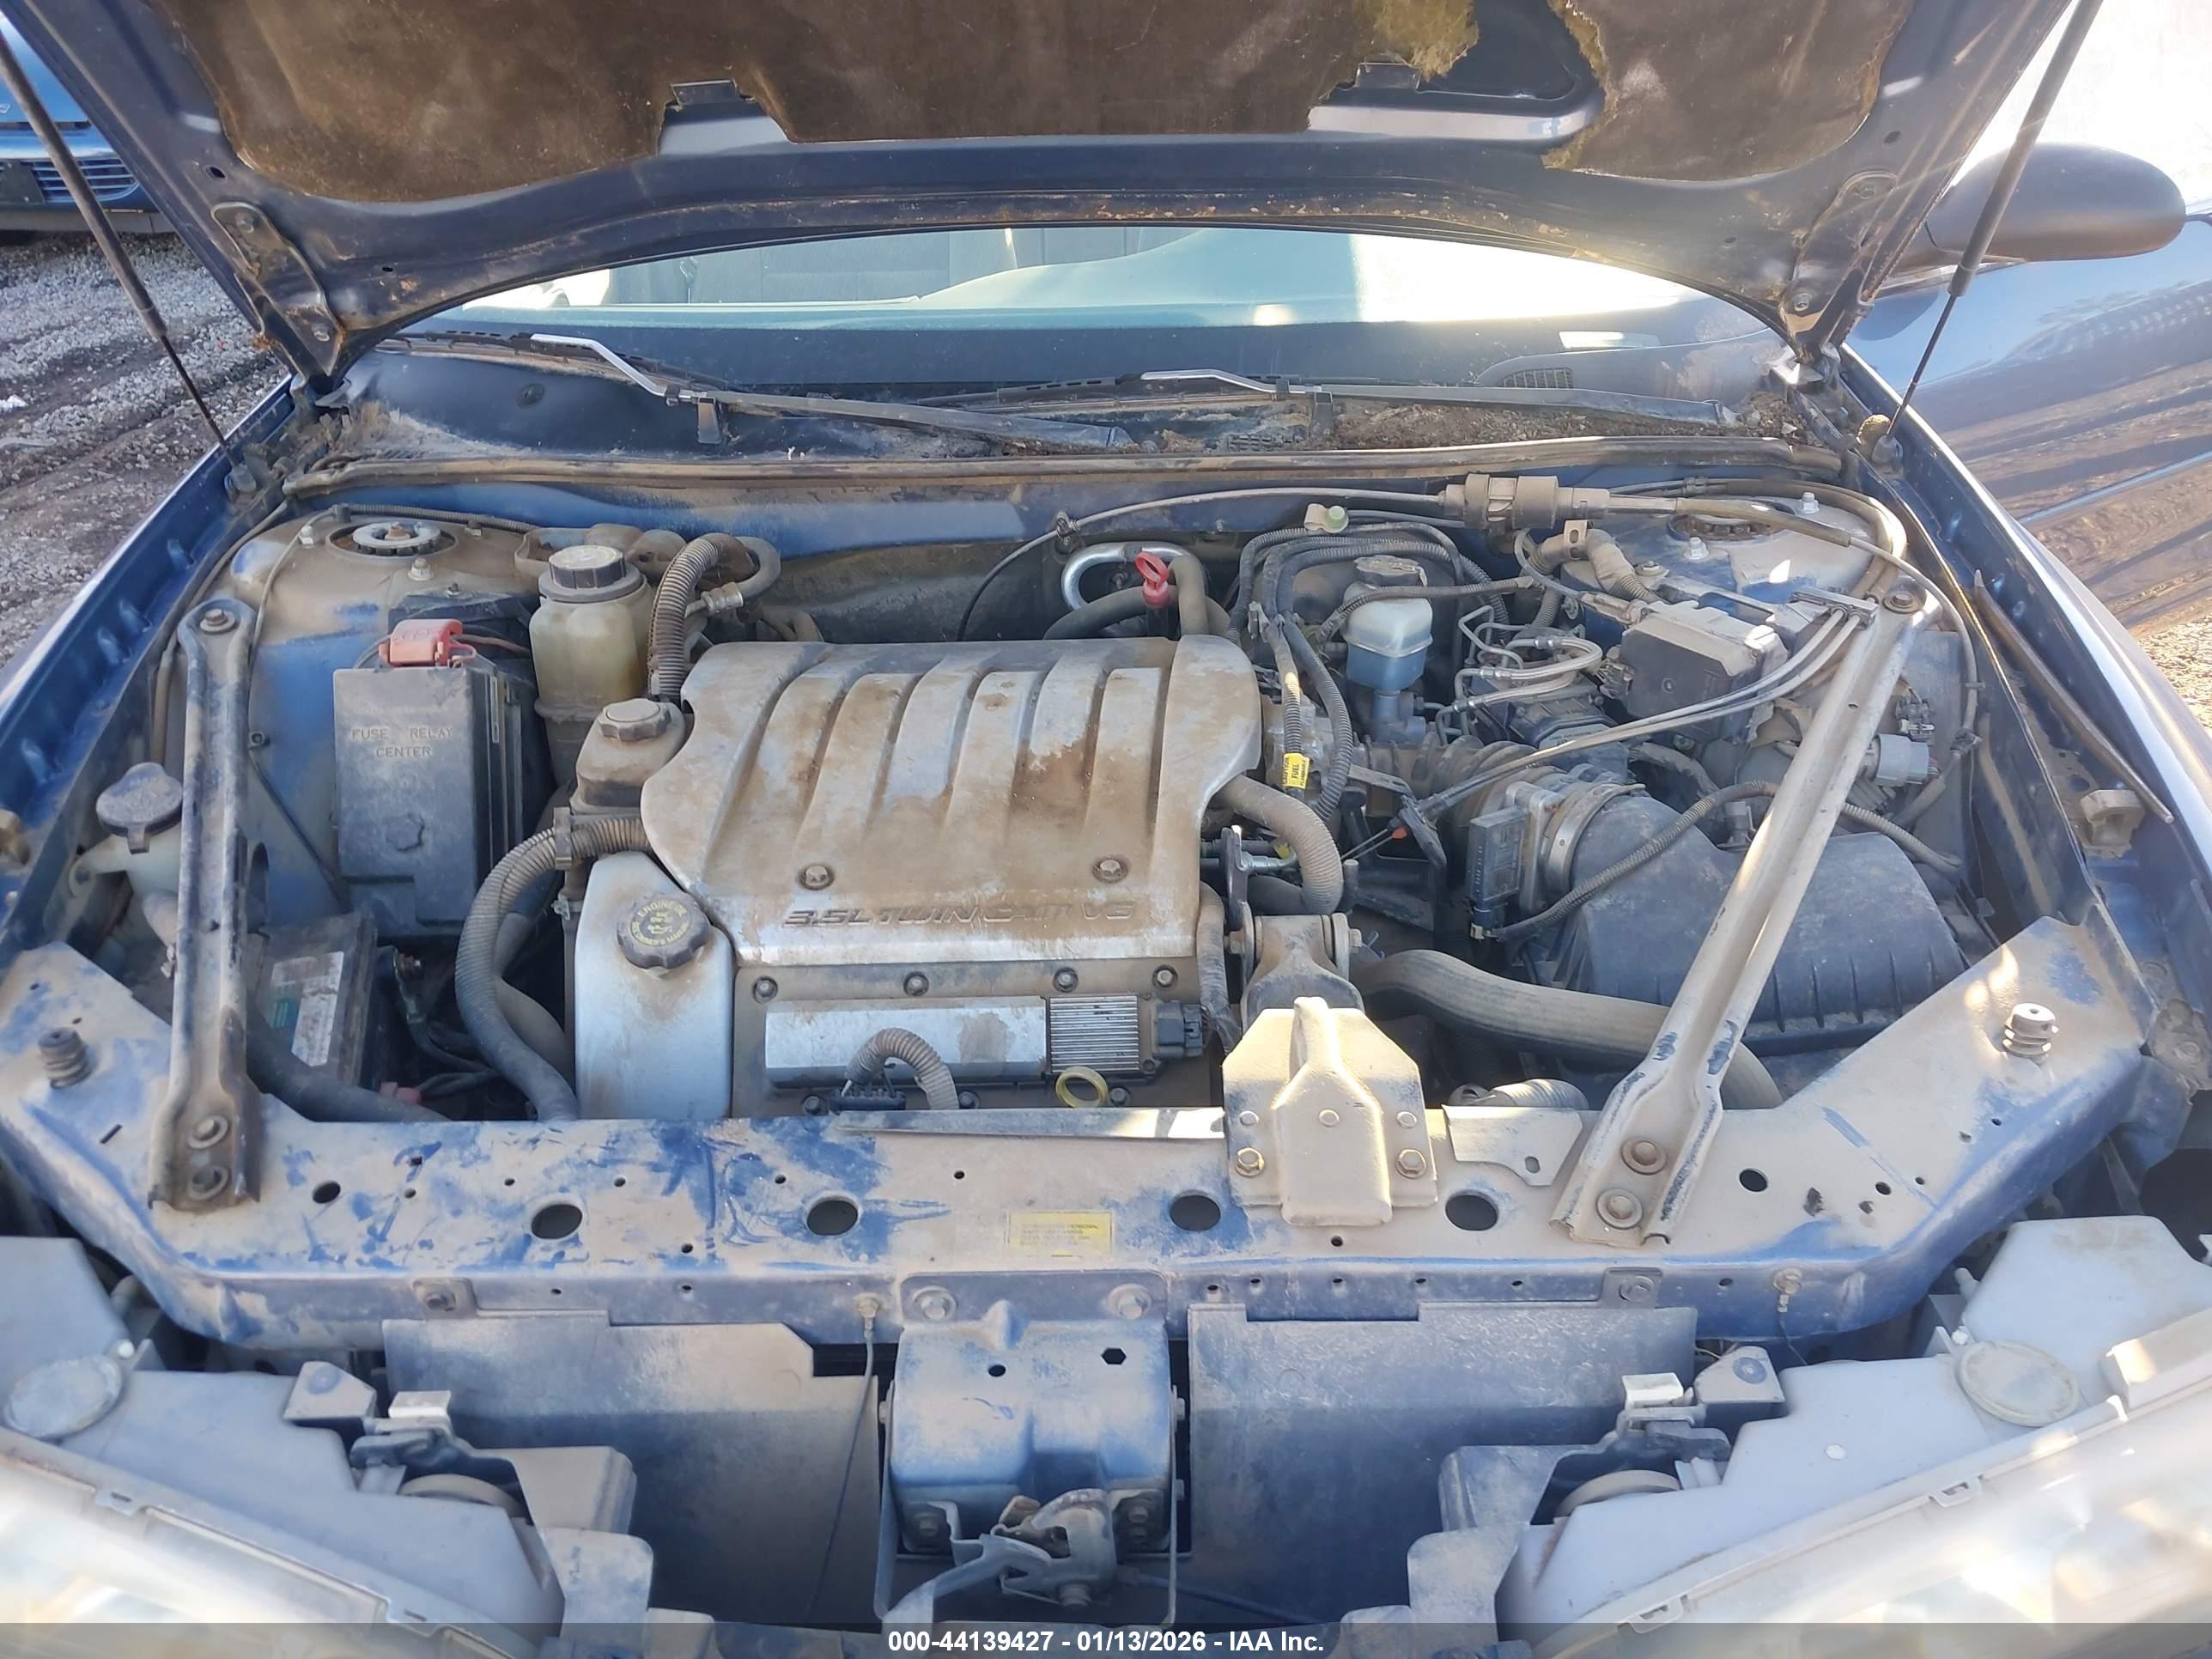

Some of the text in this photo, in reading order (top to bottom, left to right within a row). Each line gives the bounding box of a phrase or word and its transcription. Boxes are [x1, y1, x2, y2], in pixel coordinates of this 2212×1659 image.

[352, 727, 453, 741] FUSE RELAY
[376, 746, 432, 757] CENTER
[1291, 763, 1299, 780] FUEL
[782, 909, 871, 927] 3.5L
[878, 904, 980, 924] TWIN
[1082, 901, 1135, 920] V6
